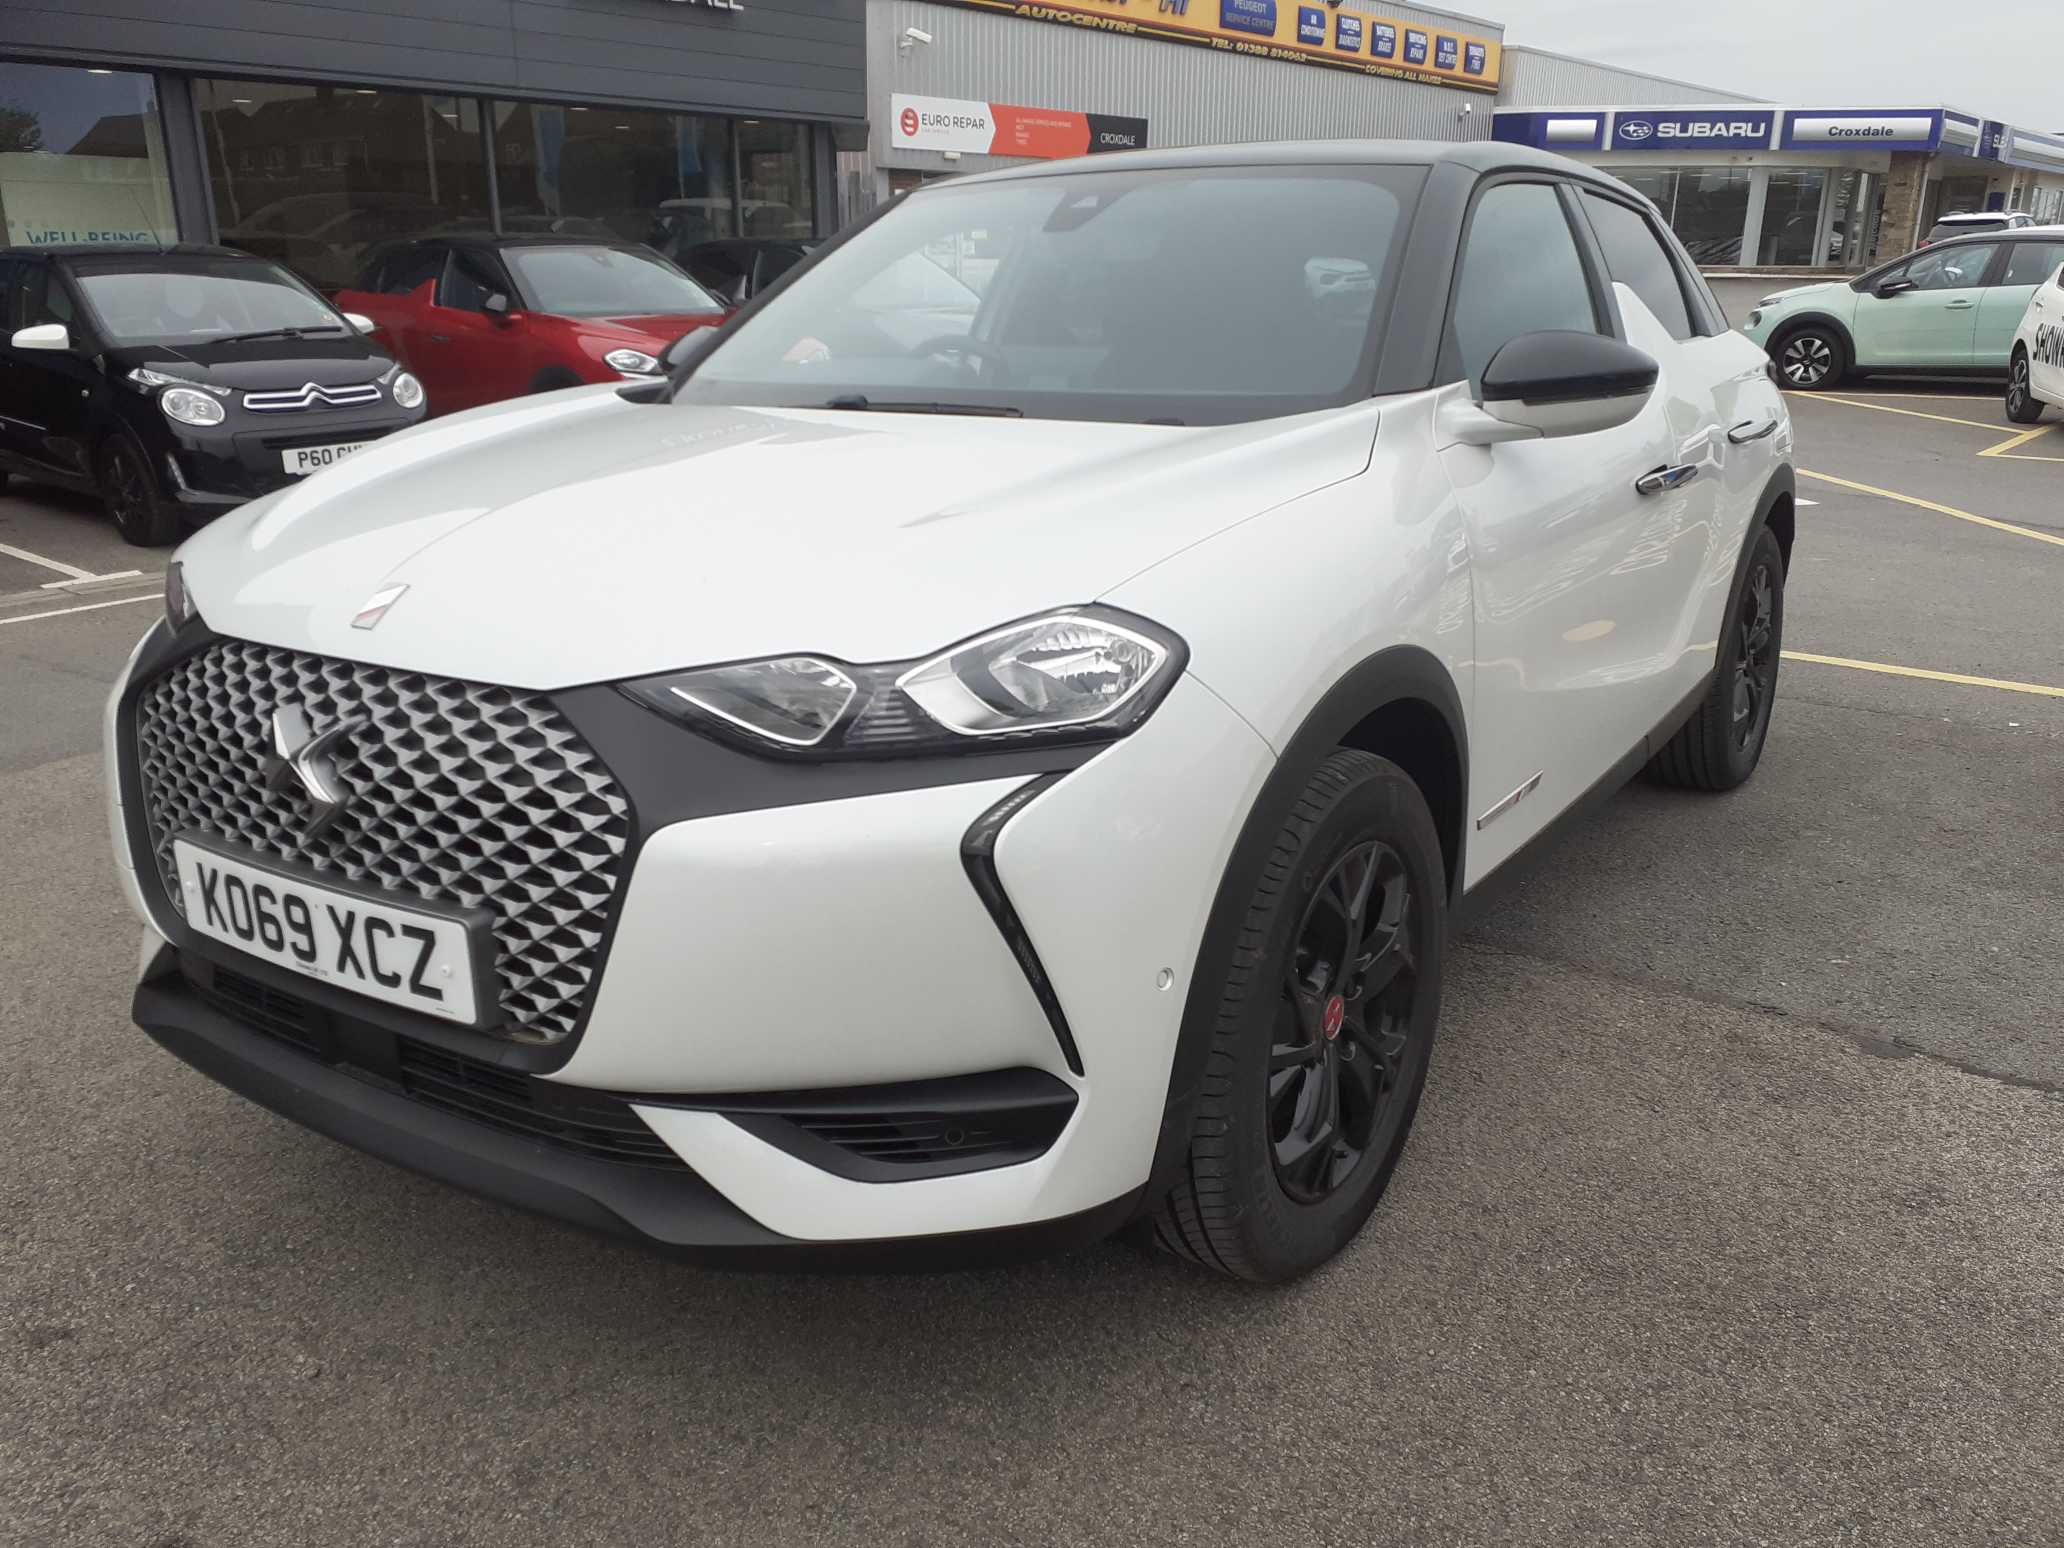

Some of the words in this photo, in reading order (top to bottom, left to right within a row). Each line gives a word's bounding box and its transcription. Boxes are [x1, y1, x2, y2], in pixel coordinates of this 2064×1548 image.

[1234, 0, 1267, 14] PEUGEOT
[1015, 5, 1137, 34] AUTOCENTRE
[922, 113, 951, 127] EURO
[953, 116, 985, 129] REPAR
[1657, 122, 1766, 138] SUBARU
[1828, 125, 1894, 138] Croxdale
[1100, 132, 1136, 146] CROXDALE
[297, 448, 333, 468] P60
[326, 904, 444, 1002] XCZ
